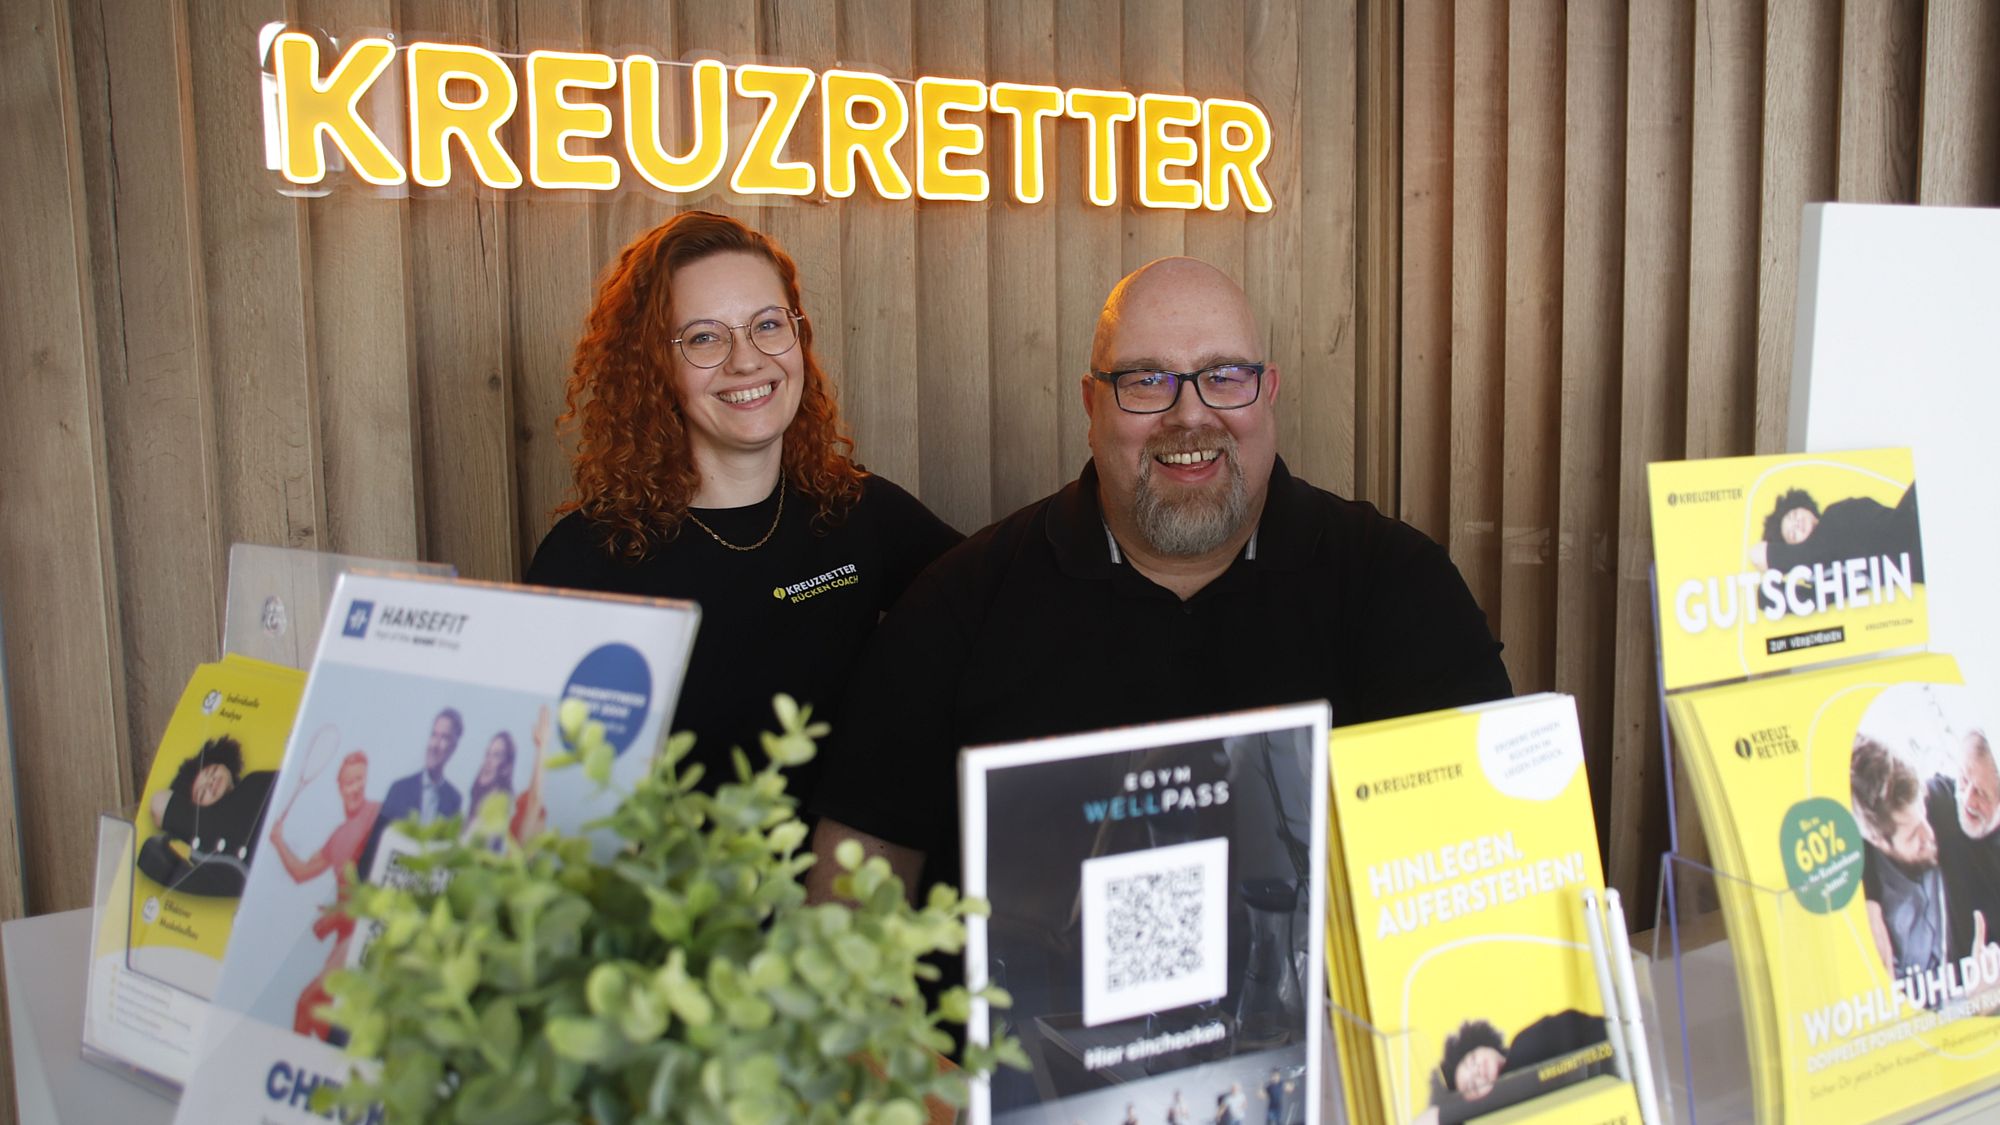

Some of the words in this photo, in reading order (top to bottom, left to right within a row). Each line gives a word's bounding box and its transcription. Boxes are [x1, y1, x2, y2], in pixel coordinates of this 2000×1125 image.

[274, 32, 1274, 213] KREUZRETTER
[1679, 487, 1743, 504] KREUZRETTER
[785, 563, 857, 596] KREUZRETTER
[790, 583, 831, 604] RÜCKEN
[830, 575, 859, 588] COACH
[1674, 552, 1914, 634] GUTSCHEIN
[379, 605, 469, 635] HANSEFIT
[1865, 617, 1914, 631] KREUZRETTER.COM
[1769, 639, 1787, 653] ZUM
[1790, 630, 1842, 648] VERSCHENKEN
[1756, 739, 1800, 759] RETTER
[1124, 766, 1191, 792] EGYM
[1372, 764, 1463, 795] KREUZRETTER
[1083, 781, 1230, 823] WELLPASS
[1795, 820, 1846, 873] 60%
[1368, 831, 1525, 899] HINLEGEN.
[1377, 851, 1586, 939] AUFERSTEHEN!
[1084, 1043, 1123, 1070] Hier
[1127, 1022, 1227, 1063] einchecken
[1538, 1042, 1613, 1083] KREUZRETTER.CO
